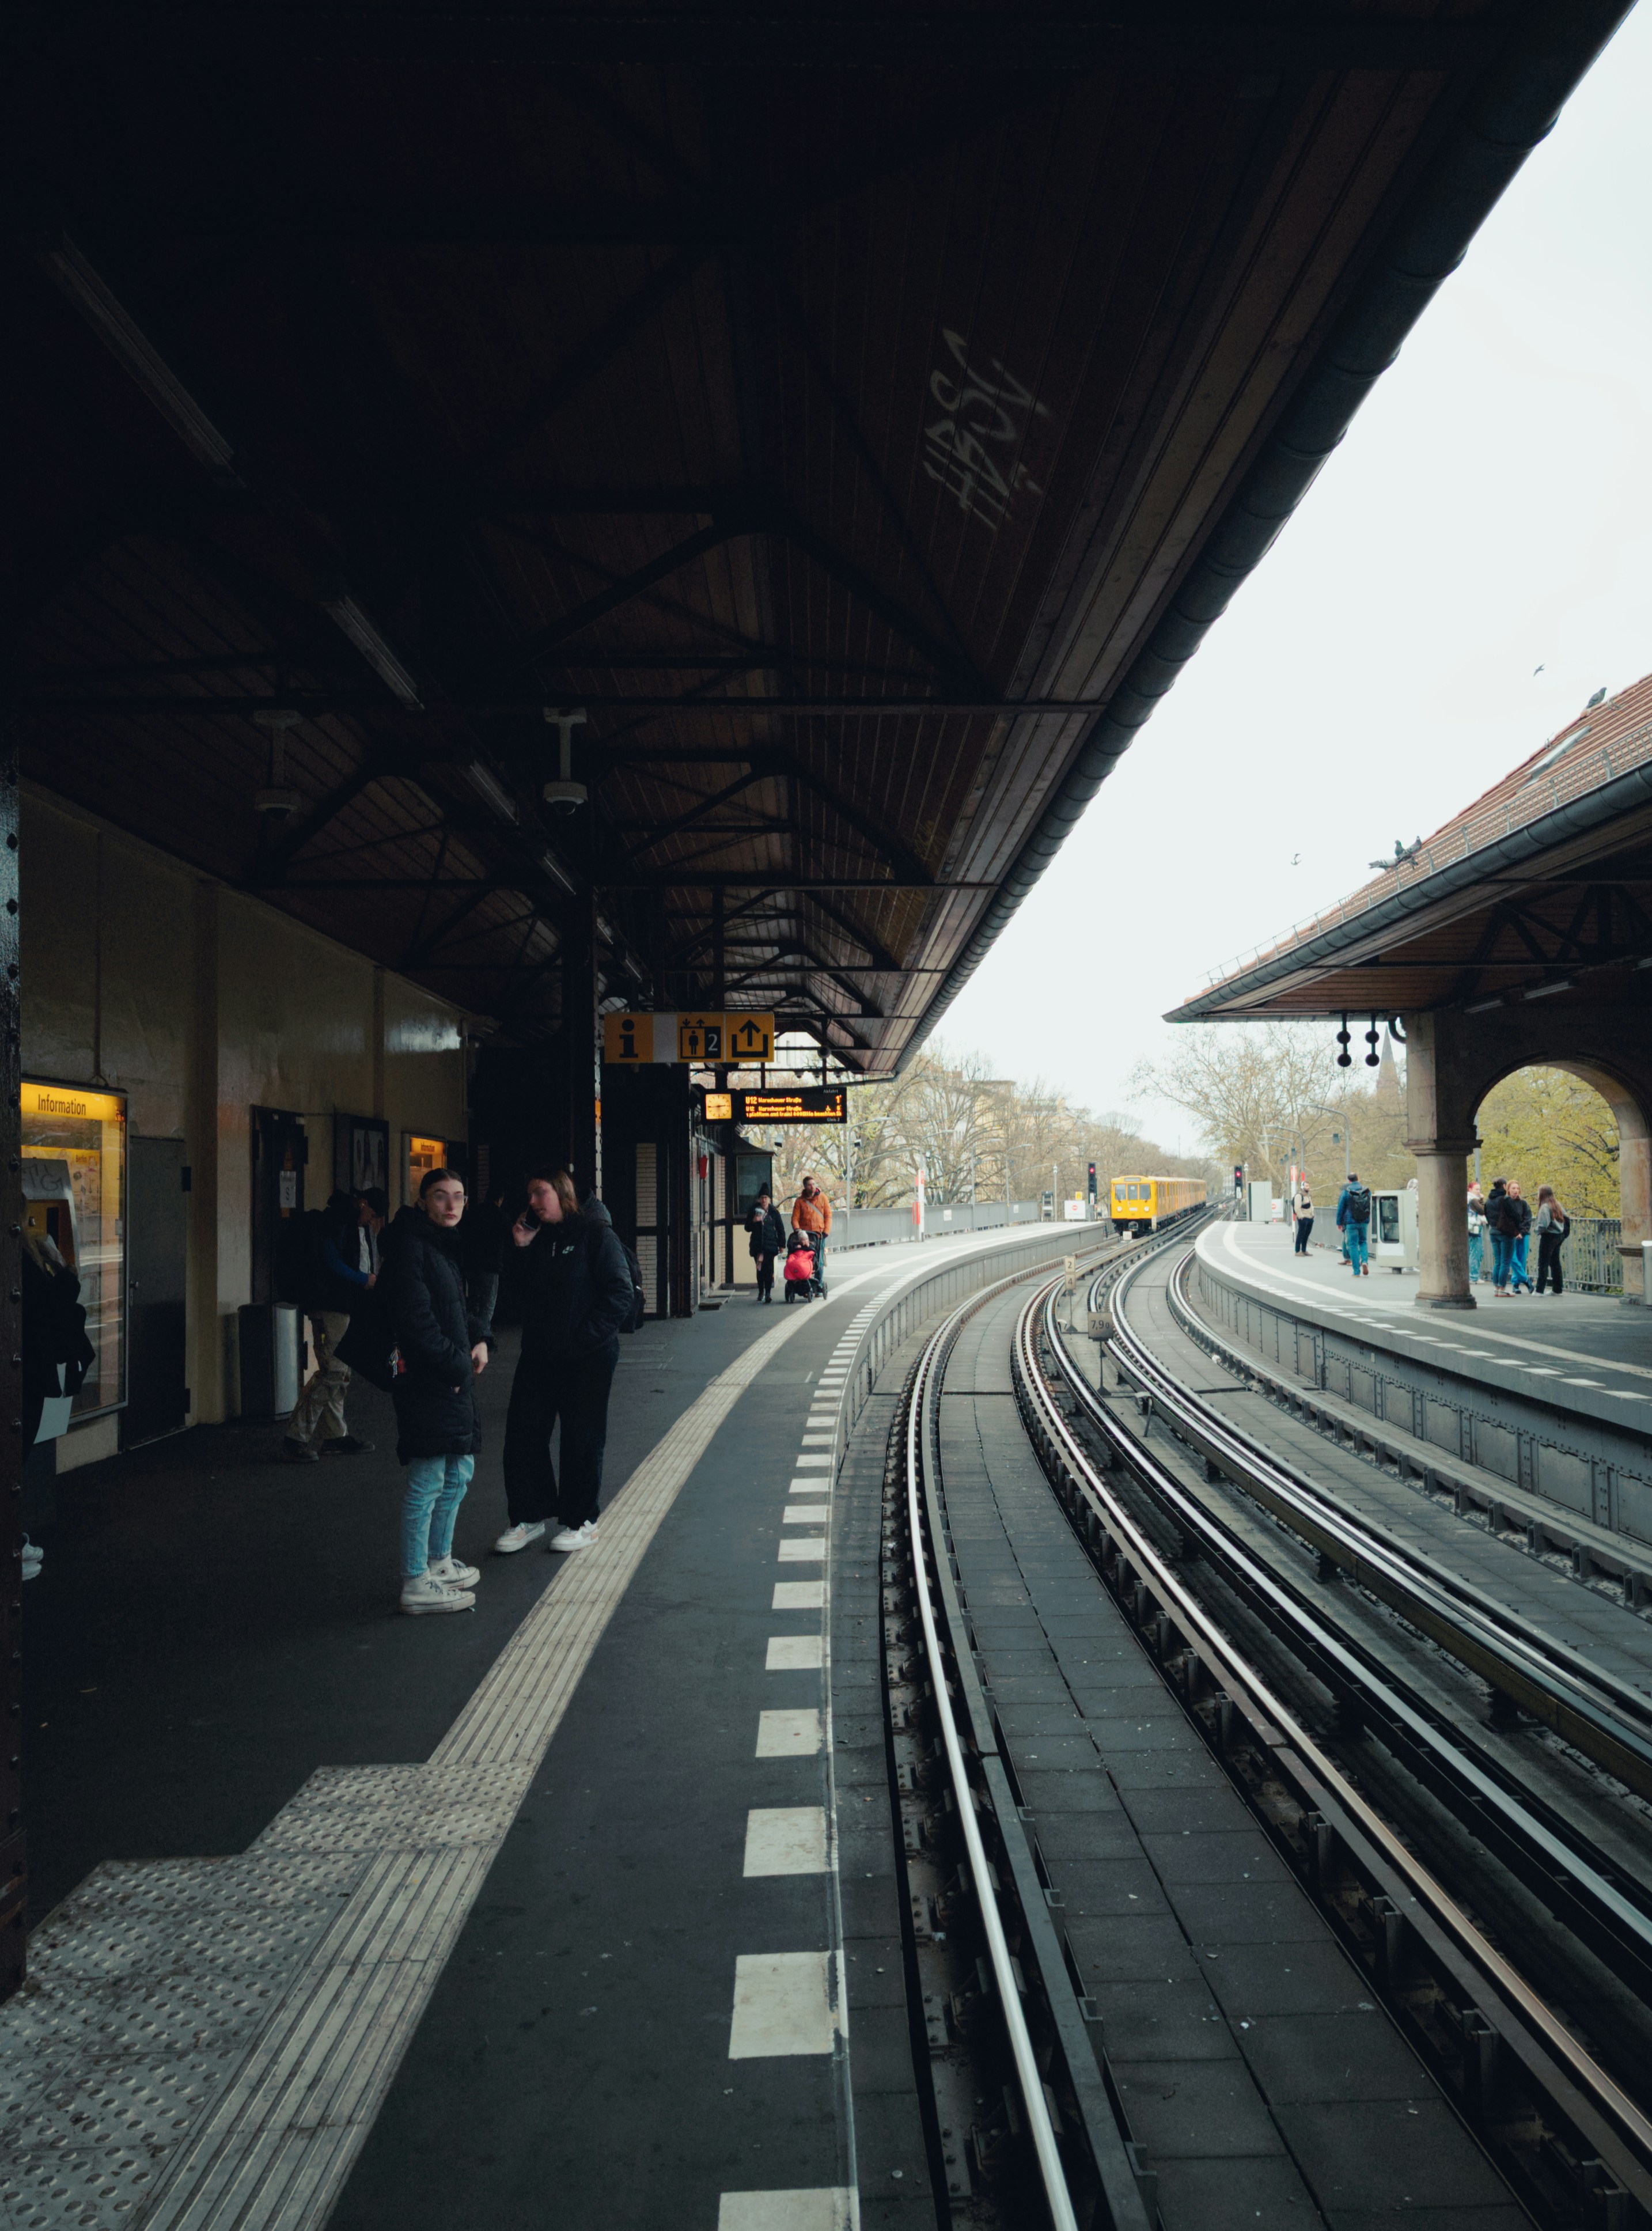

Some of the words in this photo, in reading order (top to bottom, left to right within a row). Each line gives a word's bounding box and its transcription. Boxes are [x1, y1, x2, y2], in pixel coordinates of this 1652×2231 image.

[708, 1033, 718, 1051] 2
[38, 1094, 86, 1115] Information
[745, 1096, 757, 1104] U12
[420, 1142, 435, 1152] Information
[1067, 1261, 1073, 1269] 2
